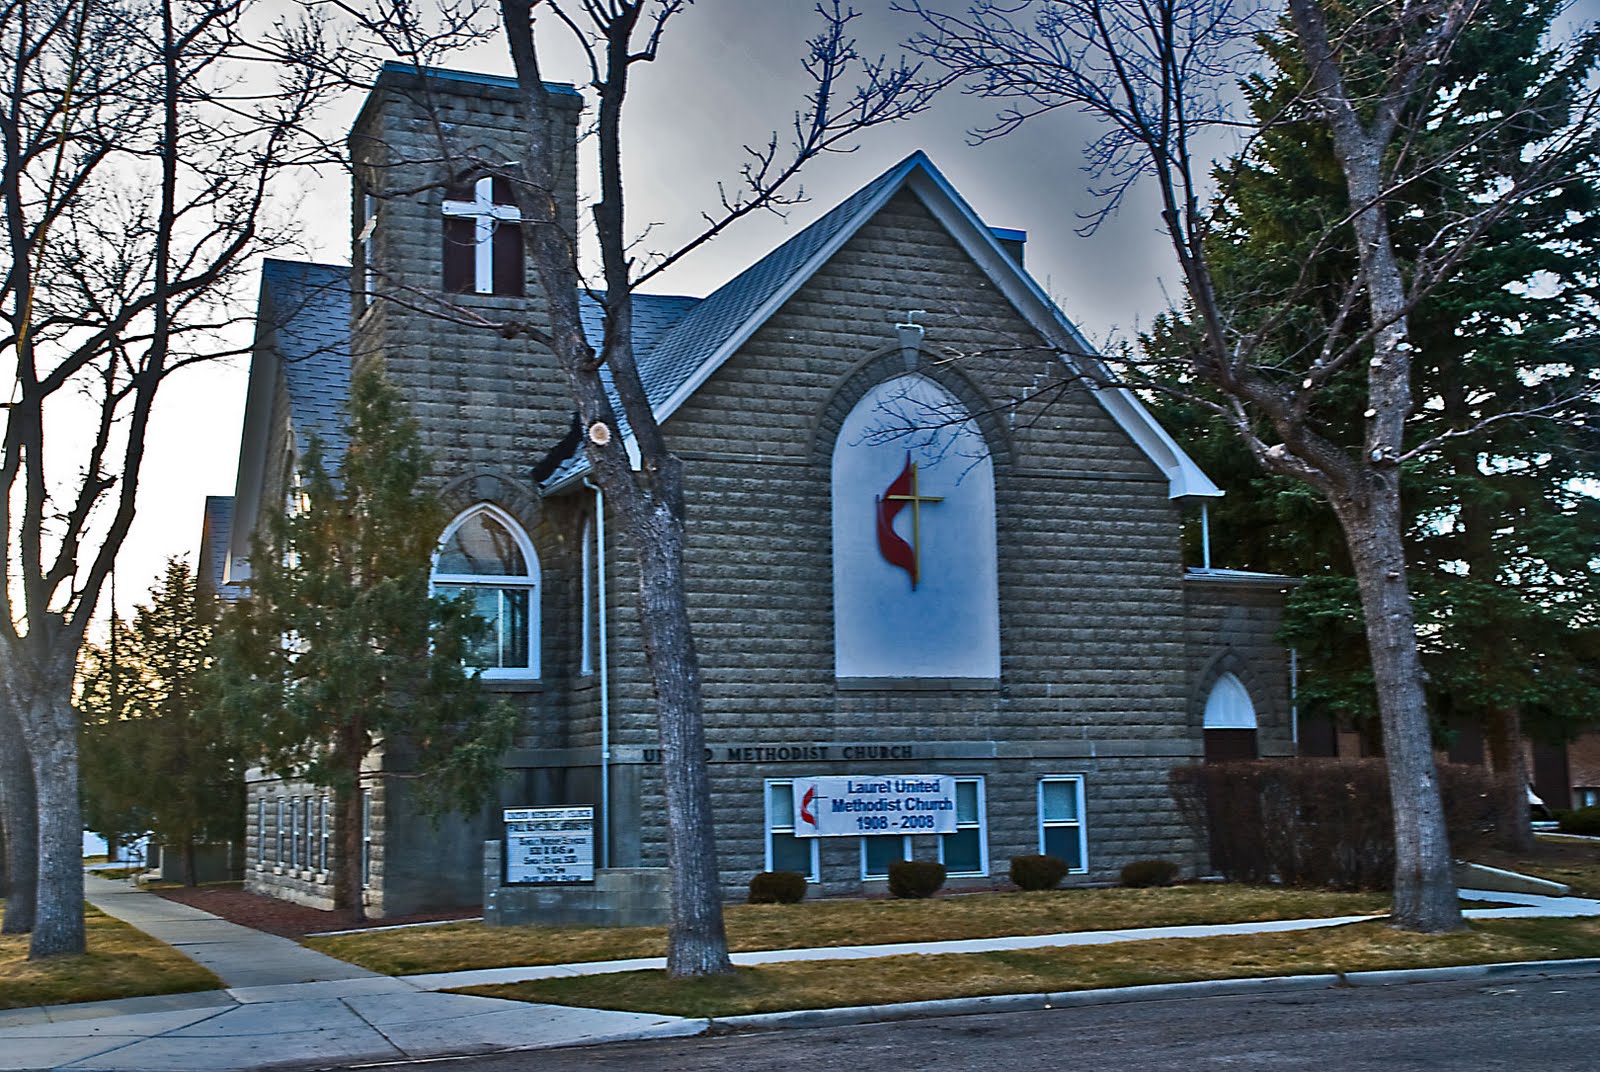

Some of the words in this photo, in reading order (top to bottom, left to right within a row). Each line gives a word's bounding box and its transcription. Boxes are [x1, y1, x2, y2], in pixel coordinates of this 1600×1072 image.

[727, 746, 829, 761] METHODIST
[842, 745, 913, 759] CHURCH
[847, 780, 892, 794] Laurel
[895, 778, 941, 794] United
[831, 797, 902, 813] Methodist
[904, 797, 954, 811] Church
[856, 815, 889, 830] 1908
[900, 815, 935, 829] 2008
